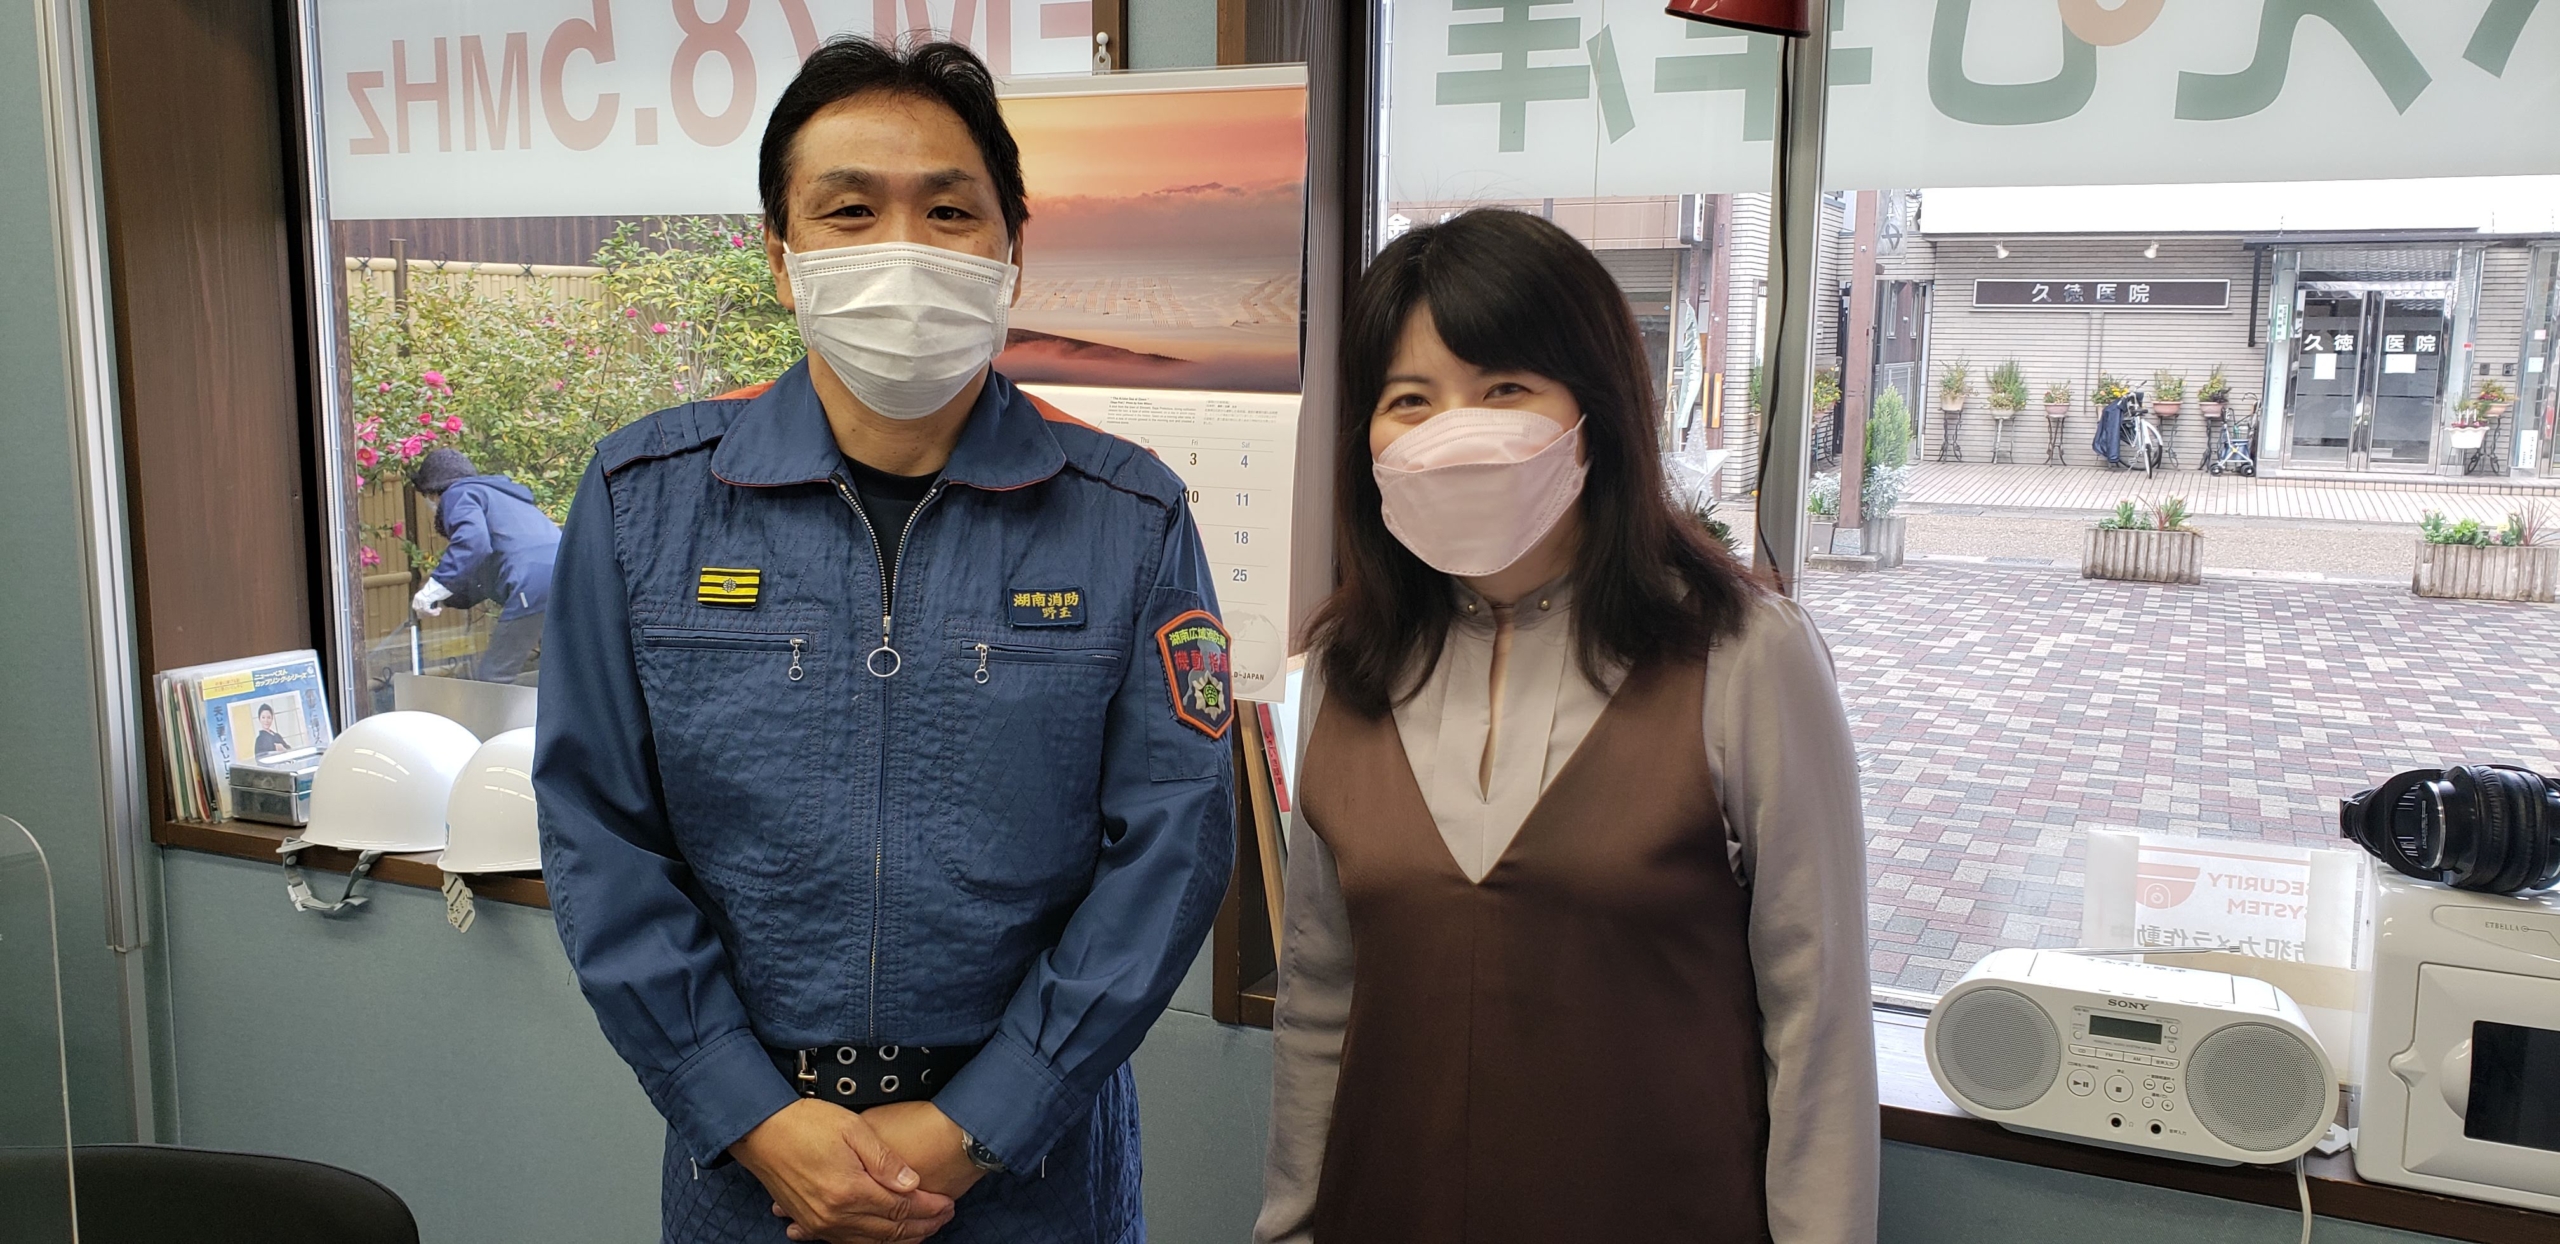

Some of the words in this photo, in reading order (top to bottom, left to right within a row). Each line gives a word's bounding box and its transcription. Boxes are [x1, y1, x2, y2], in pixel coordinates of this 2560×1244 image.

[2031, 283, 2150, 303] 久徳医院
[2304, 334, 2436, 353] 久徳医院
[1189, 452, 1197, 466] 3
[1240, 455, 1249, 468] 4
[1185, 490, 1199, 503] 10
[1236, 493, 1249, 506] 11
[1234, 531, 1249, 545] 18
[1232, 568, 1247, 582] 25
[1013, 591, 1079, 607] 湖南消防
[1231, 671, 1265, 681] D-JAPAN
[2108, 998, 2149, 1011] SONY
